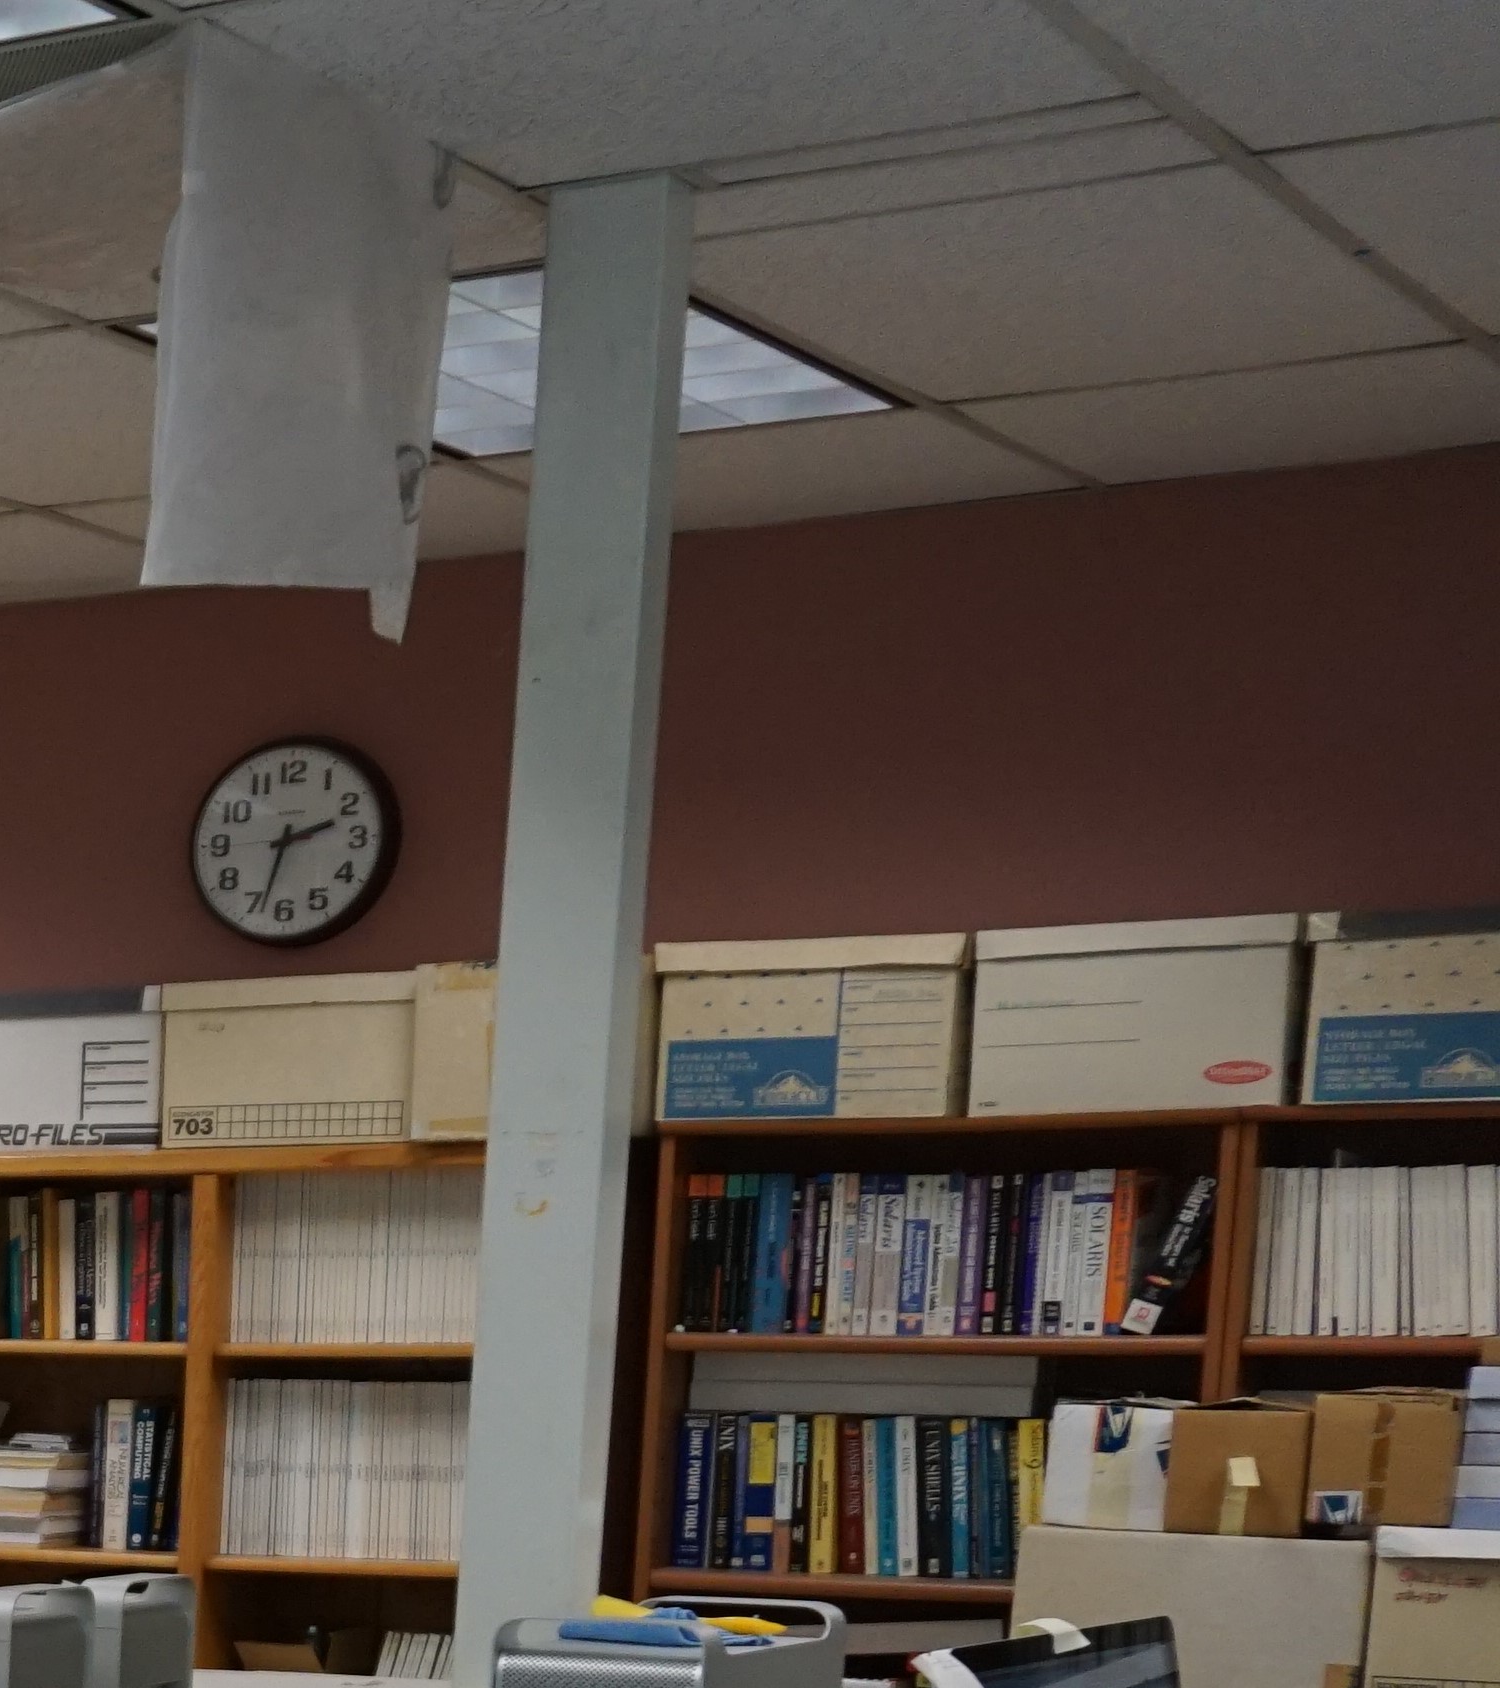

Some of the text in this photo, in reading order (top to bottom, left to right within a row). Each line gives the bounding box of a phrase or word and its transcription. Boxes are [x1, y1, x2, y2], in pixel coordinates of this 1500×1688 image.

[252, 773, 271, 795] 11
[281, 760, 307, 784] 12
[324, 768, 332, 790] 1
[223, 800, 252, 823] 10
[340, 792, 359, 816] 2
[211, 834, 230, 857] 9
[349, 825, 367, 848] 3
[219, 867, 239, 890] 8
[334, 861, 354, 883] 4
[244, 891, 263, 913] 7
[274, 899, 295, 922] 6
[309, 888, 329, 911] 5
[173, 1118, 213, 1136] 703
[1177, 1175, 1217, 1224] Solaris
[858, 1196, 877, 1240] Solaris
[880, 1196, 900, 1249] Solaris
[1086, 1206, 1110, 1278] SOLARIS
[718, 1415, 736, 1452] UNIX
[795, 1421, 809, 1464] UNIX
[133, 1421, 145, 1480] COMPUTING
[142, 1420, 155, 1481] STATISTICAL
[901, 1447, 913, 1472] UNIX
[924, 1430, 942, 1513] UNIX SHELLS
[952, 1464, 968, 1501] UNIX
[683, 1430, 704, 1539] UNIX POWER TOOLS
[846, 1490, 861, 1516] UNIX
